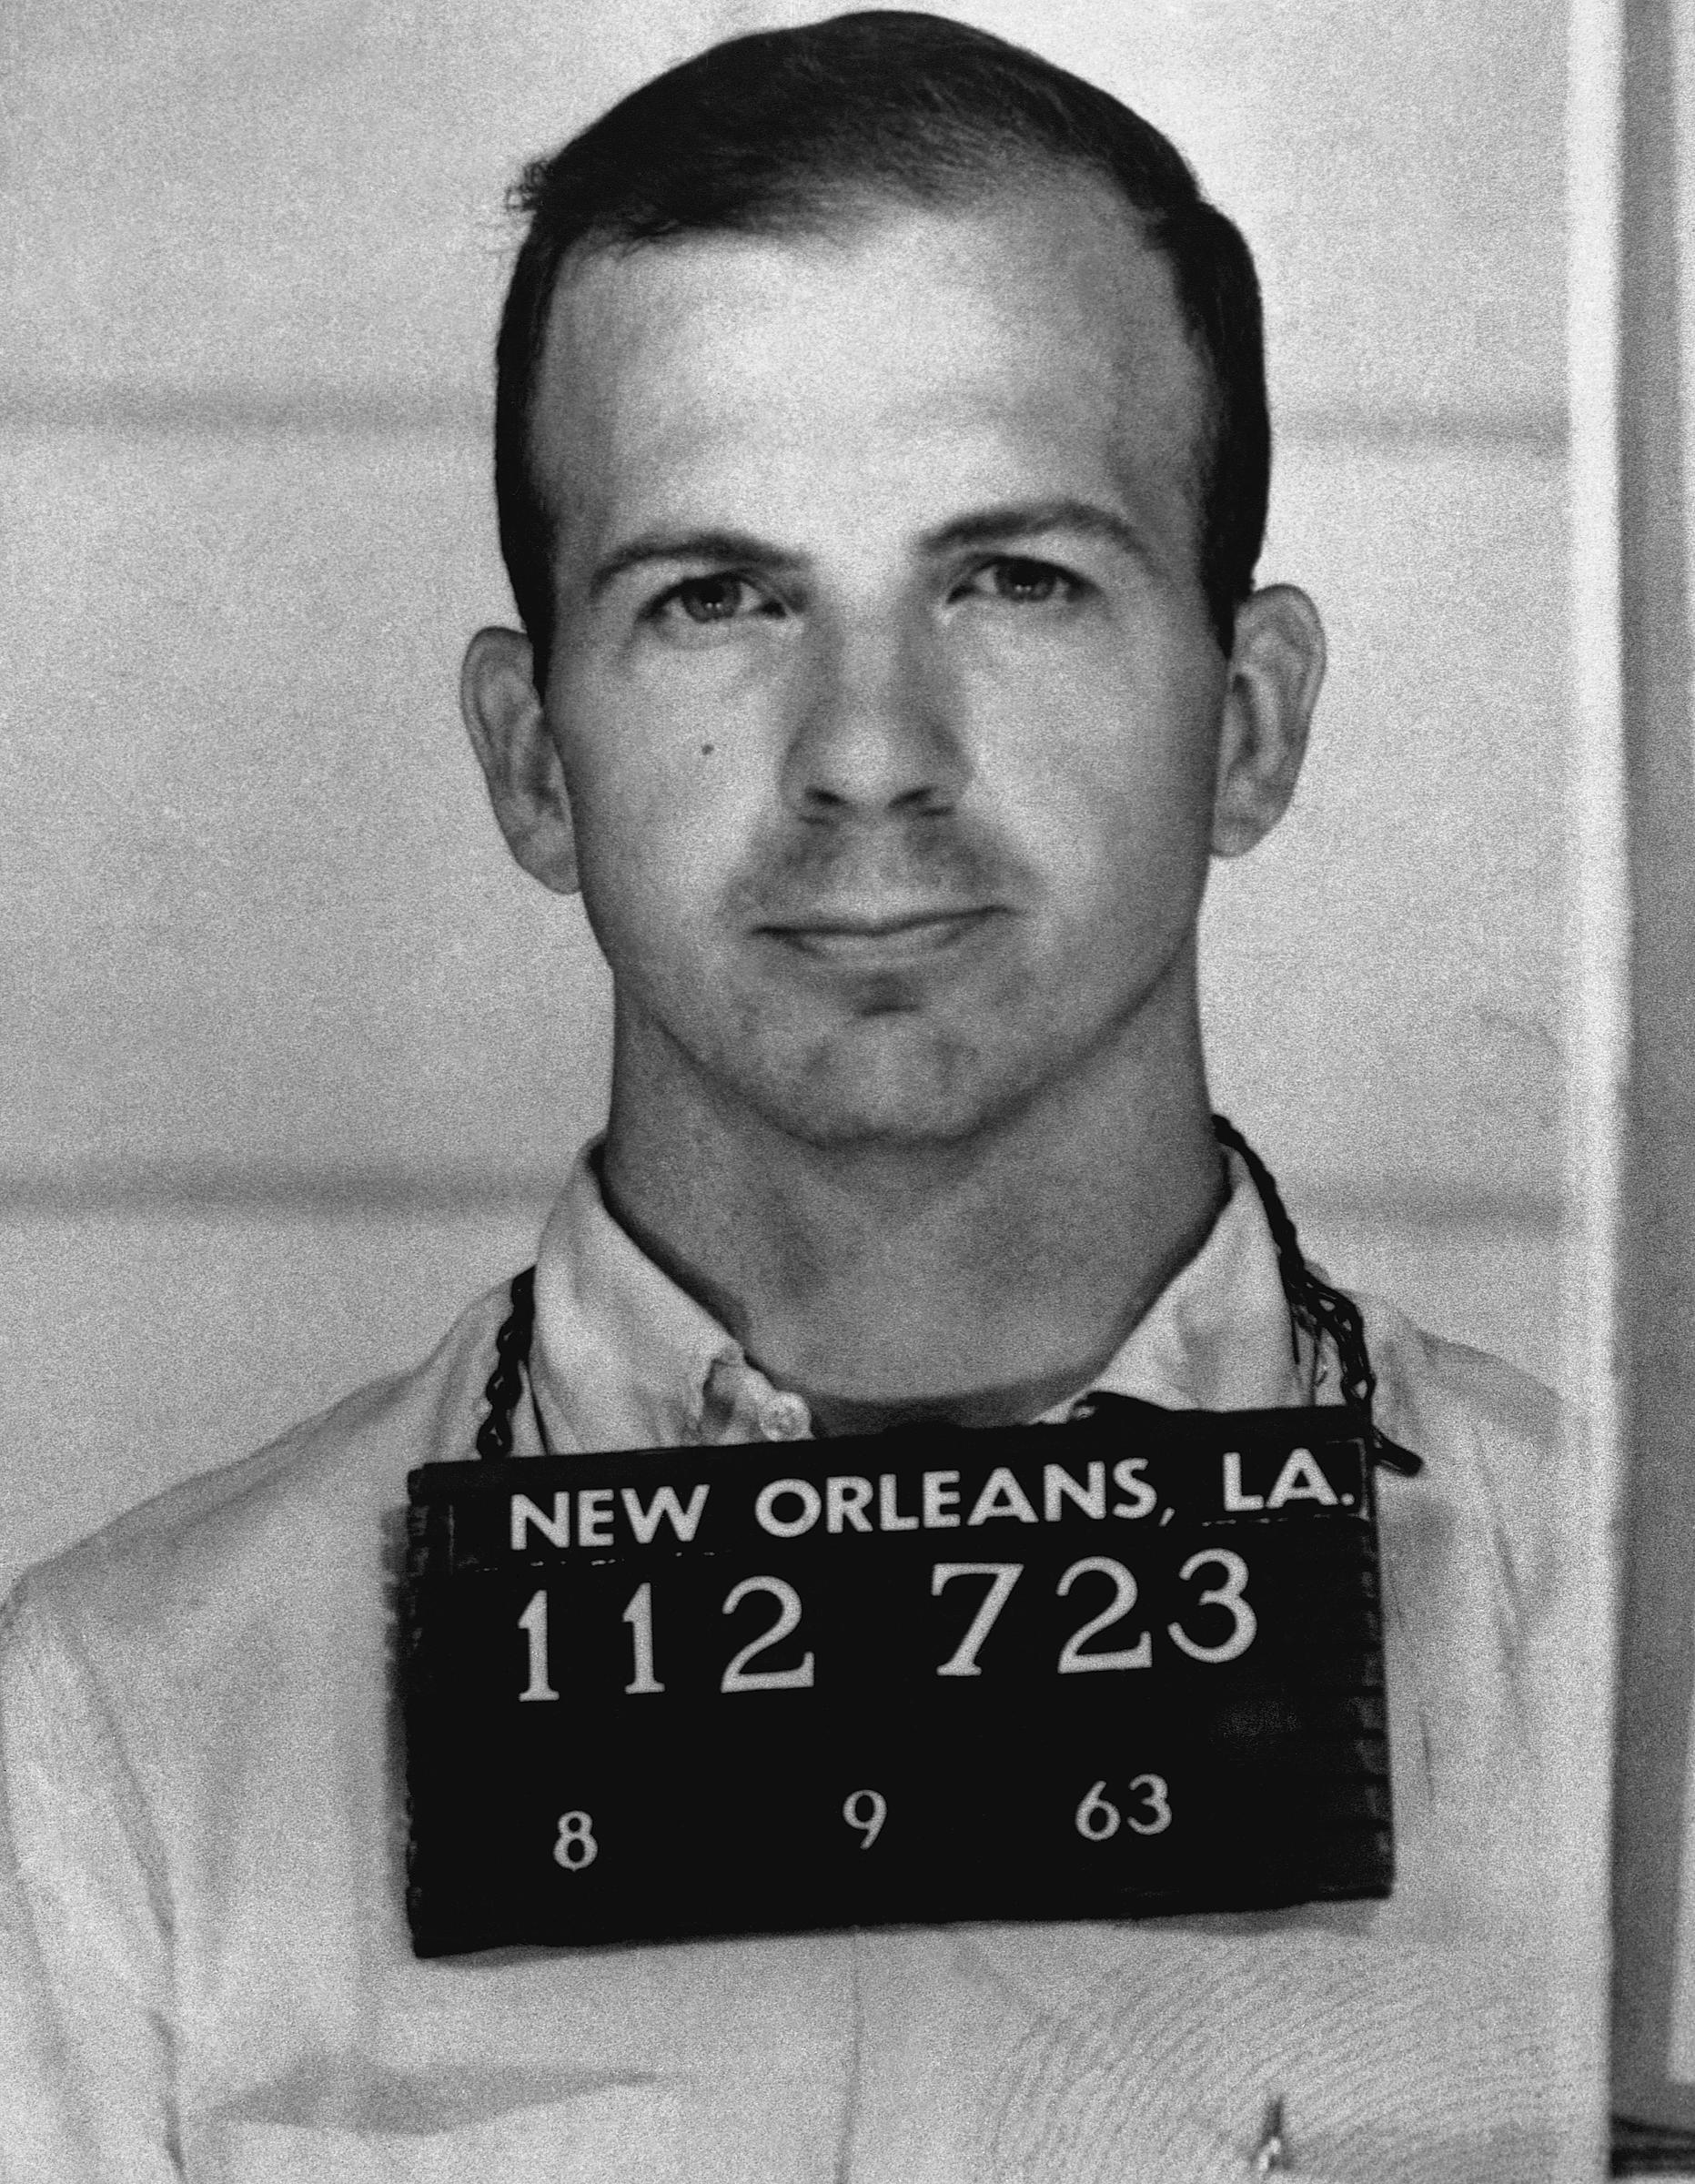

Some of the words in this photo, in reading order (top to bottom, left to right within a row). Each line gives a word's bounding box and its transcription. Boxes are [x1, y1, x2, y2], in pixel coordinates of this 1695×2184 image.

[510, 1483, 711, 1551] NEW
[754, 1458, 1175, 1538] ORLEANS,
[1223, 1448, 1355, 1512] LA.
[518, 1574, 815, 1702] 112
[932, 1548, 1257, 1677] 723
[553, 1810, 599, 1872] 8
[842, 1790, 887, 1850] 9
[1075, 1774, 1172, 1841] 63
